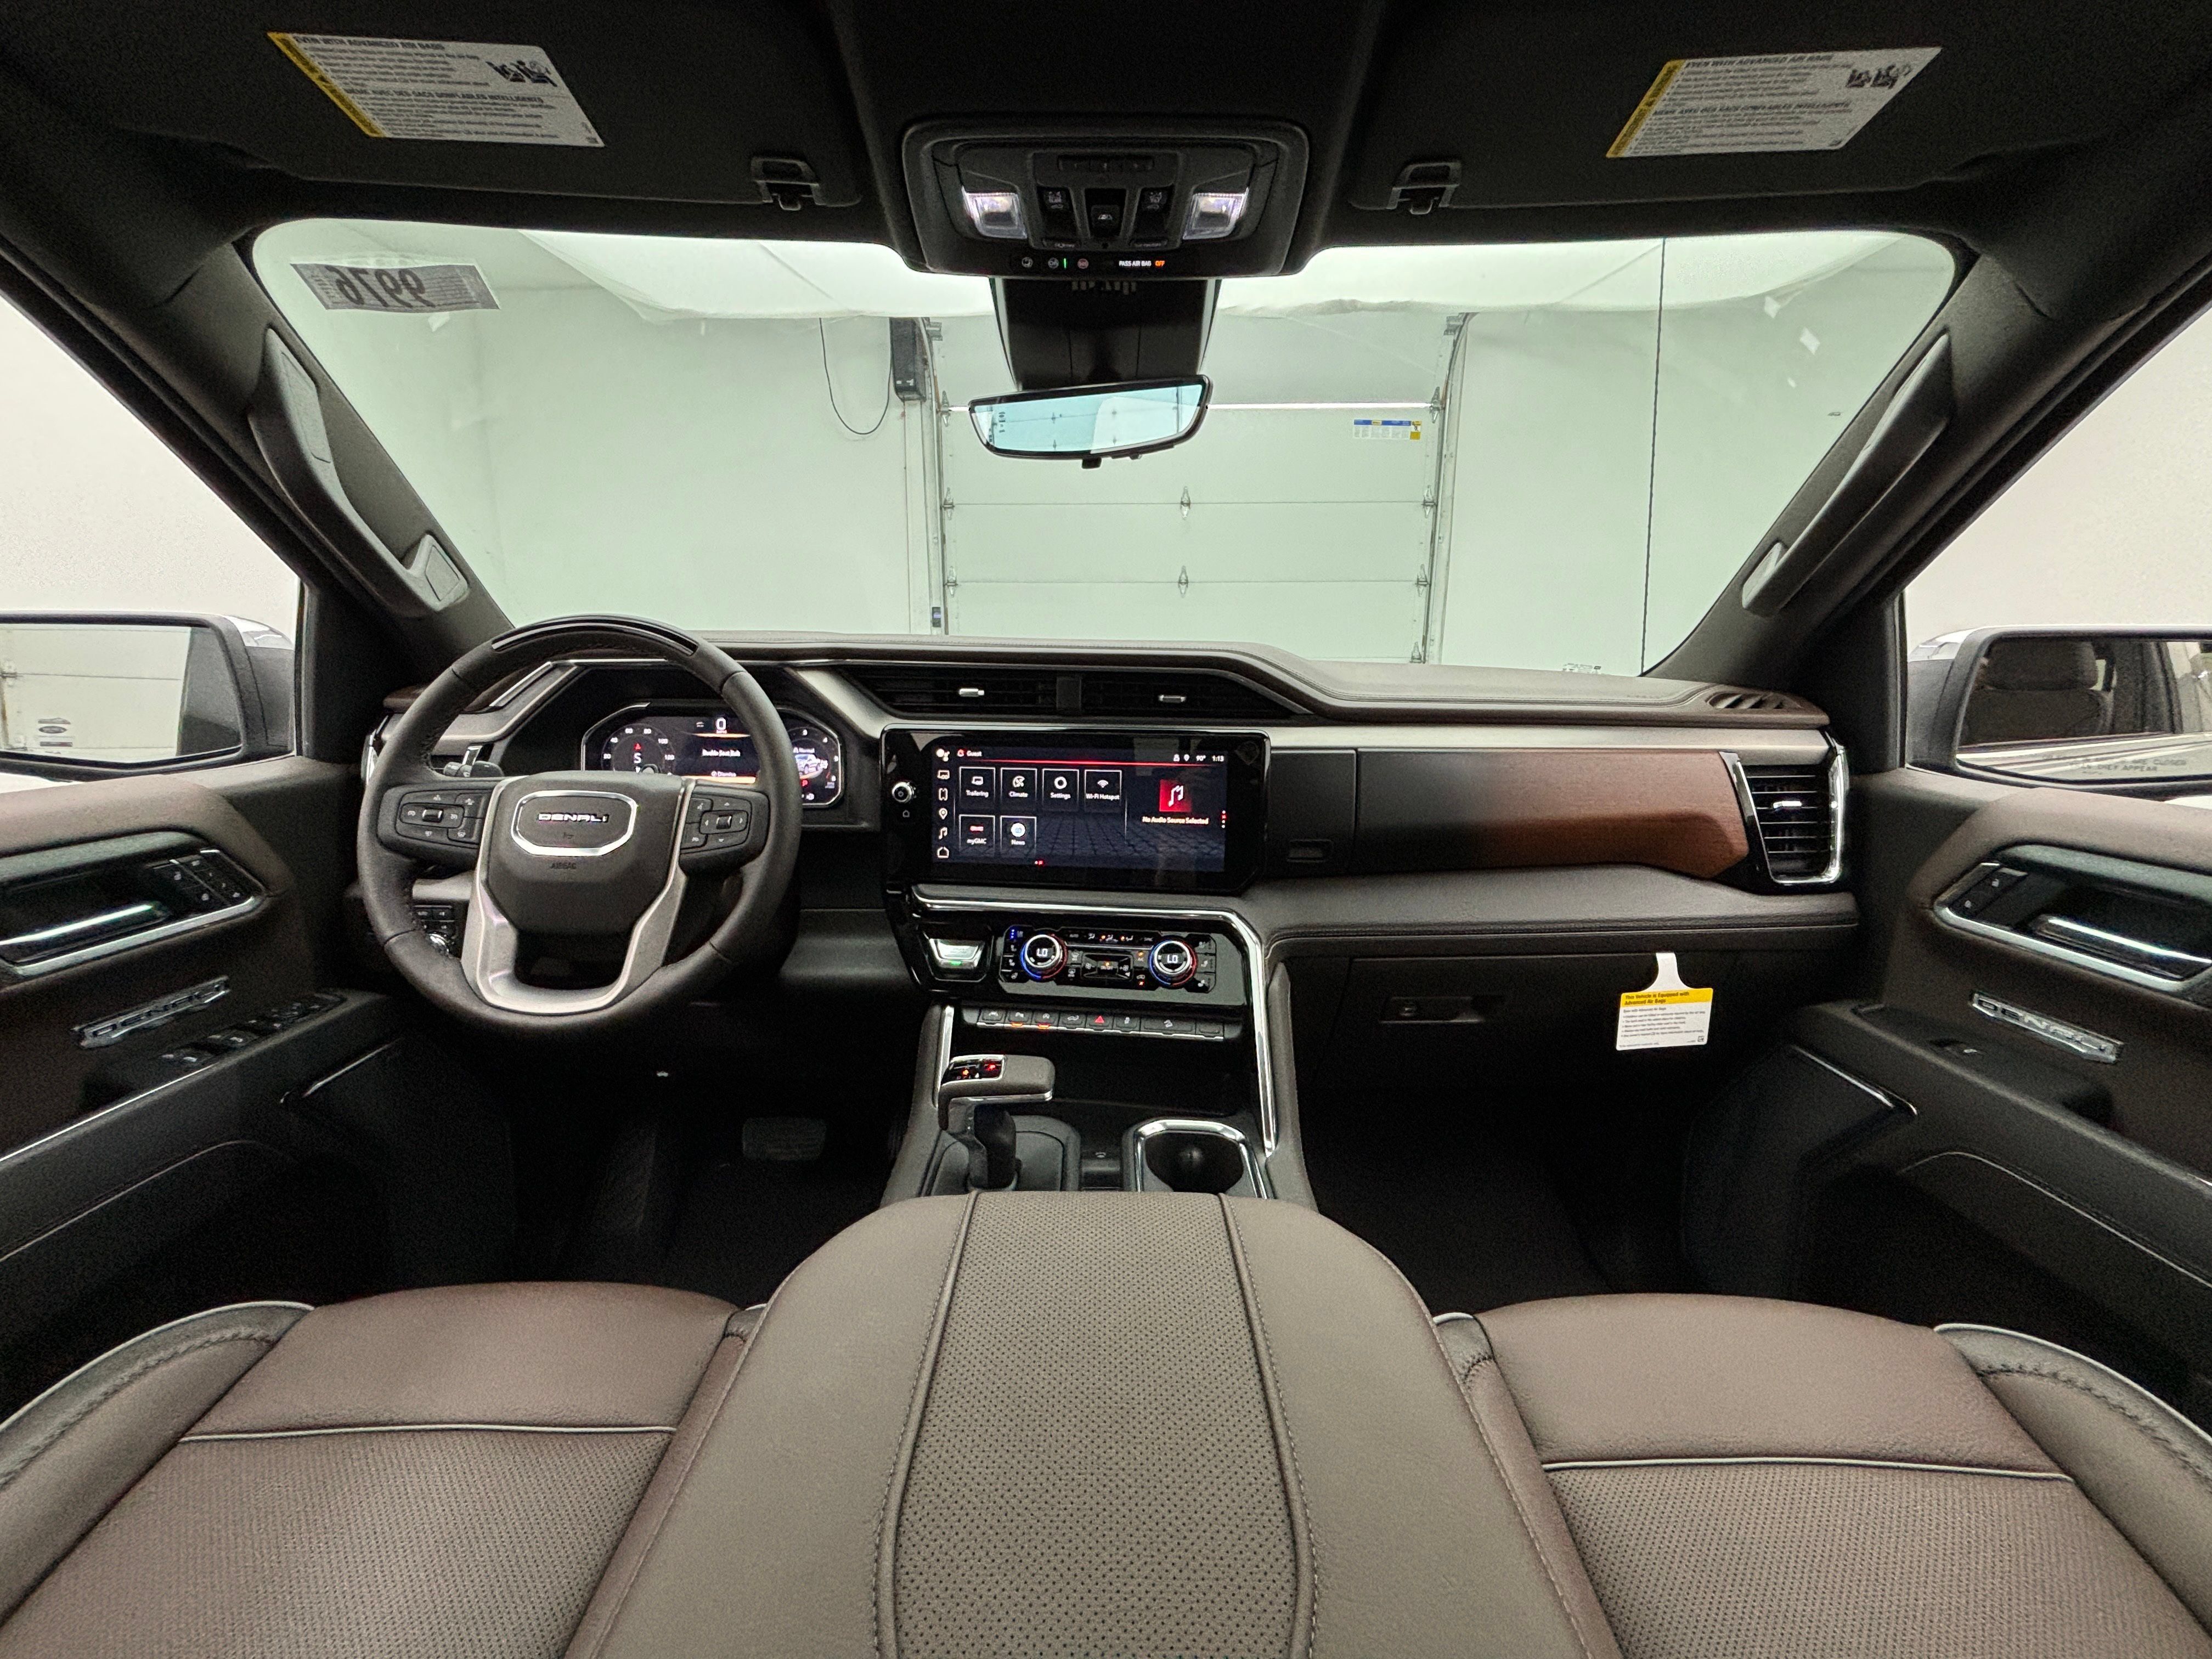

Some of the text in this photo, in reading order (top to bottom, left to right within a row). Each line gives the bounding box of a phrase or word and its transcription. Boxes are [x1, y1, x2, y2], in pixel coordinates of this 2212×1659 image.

[716, 718, 726, 730] 0
[634, 753, 641, 763] S
[966, 789, 989, 798] Trailering
[538, 813, 608, 822] DENALI
[1036, 948, 1048, 957] LO
[1167, 955, 1178, 963] LO
[1977, 998, 2107, 1052] DENALI
